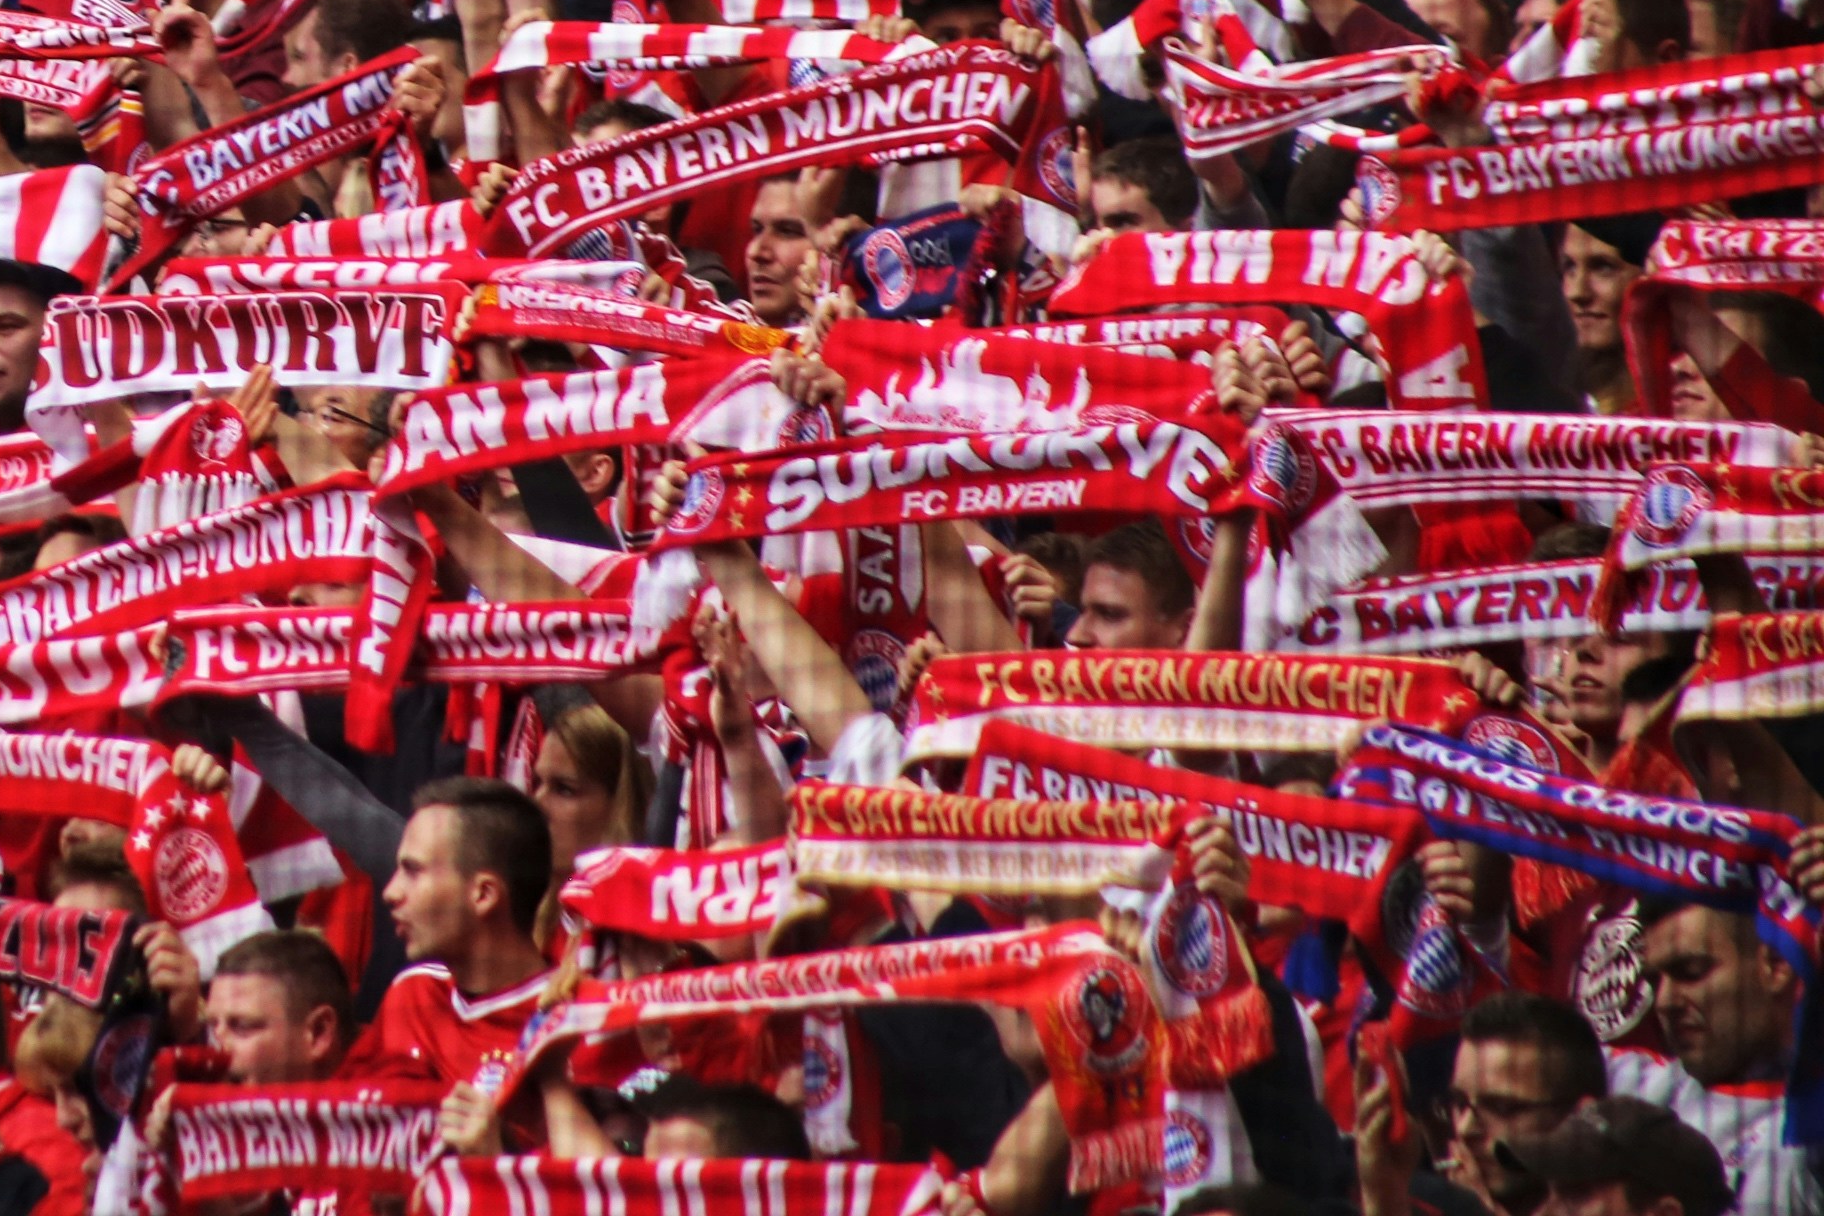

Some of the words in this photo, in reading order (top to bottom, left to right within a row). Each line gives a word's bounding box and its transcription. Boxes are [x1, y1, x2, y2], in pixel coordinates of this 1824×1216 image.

[187, 97, 330, 191] BAYERN
[506, 189, 569, 247] FC
[577, 113, 769, 210] BAYERN
[780, 70, 1031, 148] MÜNCHEN
[1427, 157, 1480, 206] FC
[1481, 137, 1632, 195] BAYERN
[358, 198, 466, 258] MIA
[522, 362, 670, 440] MIA
[1361, 422, 1515, 476] BAYERN
[1528, 423, 1742, 472] MÜNCHEN
[902, 487, 947, 518] FC
[958, 479, 1088, 515] BAYERN
[1358, 572, 1589, 644] BAYERN
[194, 626, 248, 678] FC
[976, 659, 1029, 706] FC
[1031, 654, 1196, 702] BAYERN
[1200, 653, 1411, 721] MÜNCHEN
[798, 787, 846, 835] FC
[846, 787, 979, 838] BAYERN
[1363, 723, 1547, 794] adidas
[1560, 785, 1751, 844] adidas
[178, 1092, 320, 1181] BAYERN
